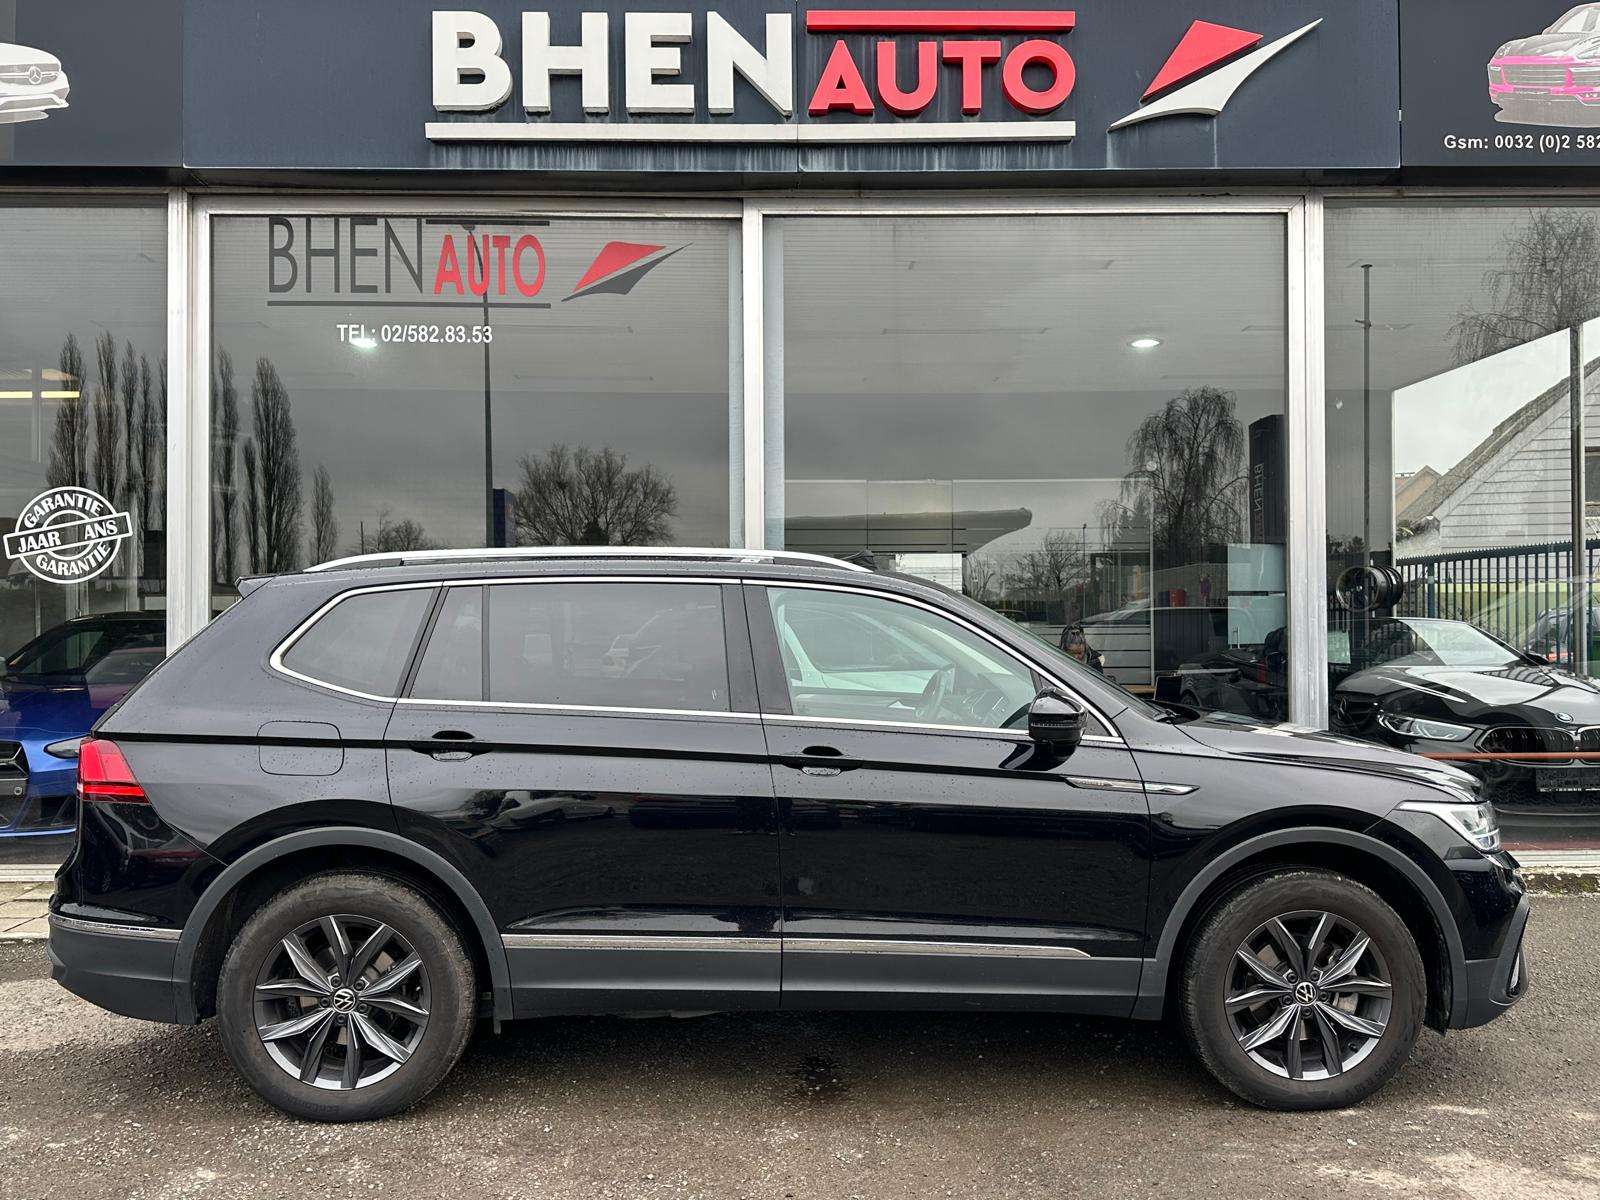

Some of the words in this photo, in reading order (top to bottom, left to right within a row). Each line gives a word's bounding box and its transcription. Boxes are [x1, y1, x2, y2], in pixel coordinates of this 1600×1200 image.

[432, 10, 793, 117] BHEN
[808, 38, 1076, 116] AUTO
[1444, 135, 1488, 149] Gsm:
[1494, 135, 1534, 149] 0032
[1539, 135, 1570, 152] (0)2
[268, 216, 423, 294] BHEN
[433, 234, 546, 297] AUTO
[336, 324, 376, 343] TEL:
[381, 324, 493, 343] 02/582.83.53
[23, 492, 104, 529] GARANTIE
[18, 531, 62, 553] JAAR
[84, 519, 118, 540] ANS
[35, 540, 111, 576] GARANTIE
